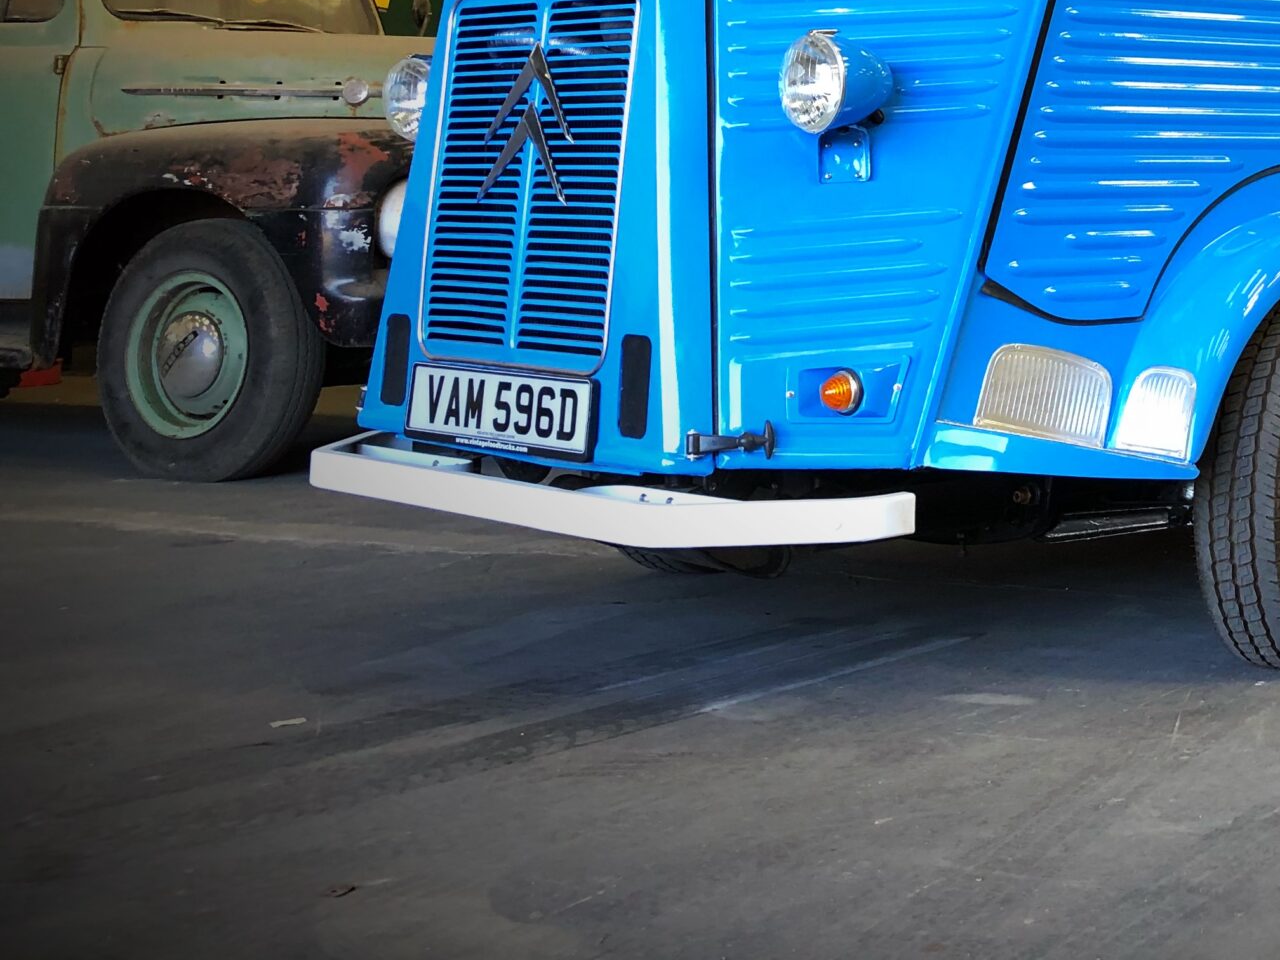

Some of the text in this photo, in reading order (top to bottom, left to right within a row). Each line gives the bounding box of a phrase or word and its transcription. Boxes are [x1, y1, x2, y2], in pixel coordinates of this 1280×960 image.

[428, 374, 579, 441] VAM 596D
[455, 437, 529, 453] www.vintagefoodtrucks.com
